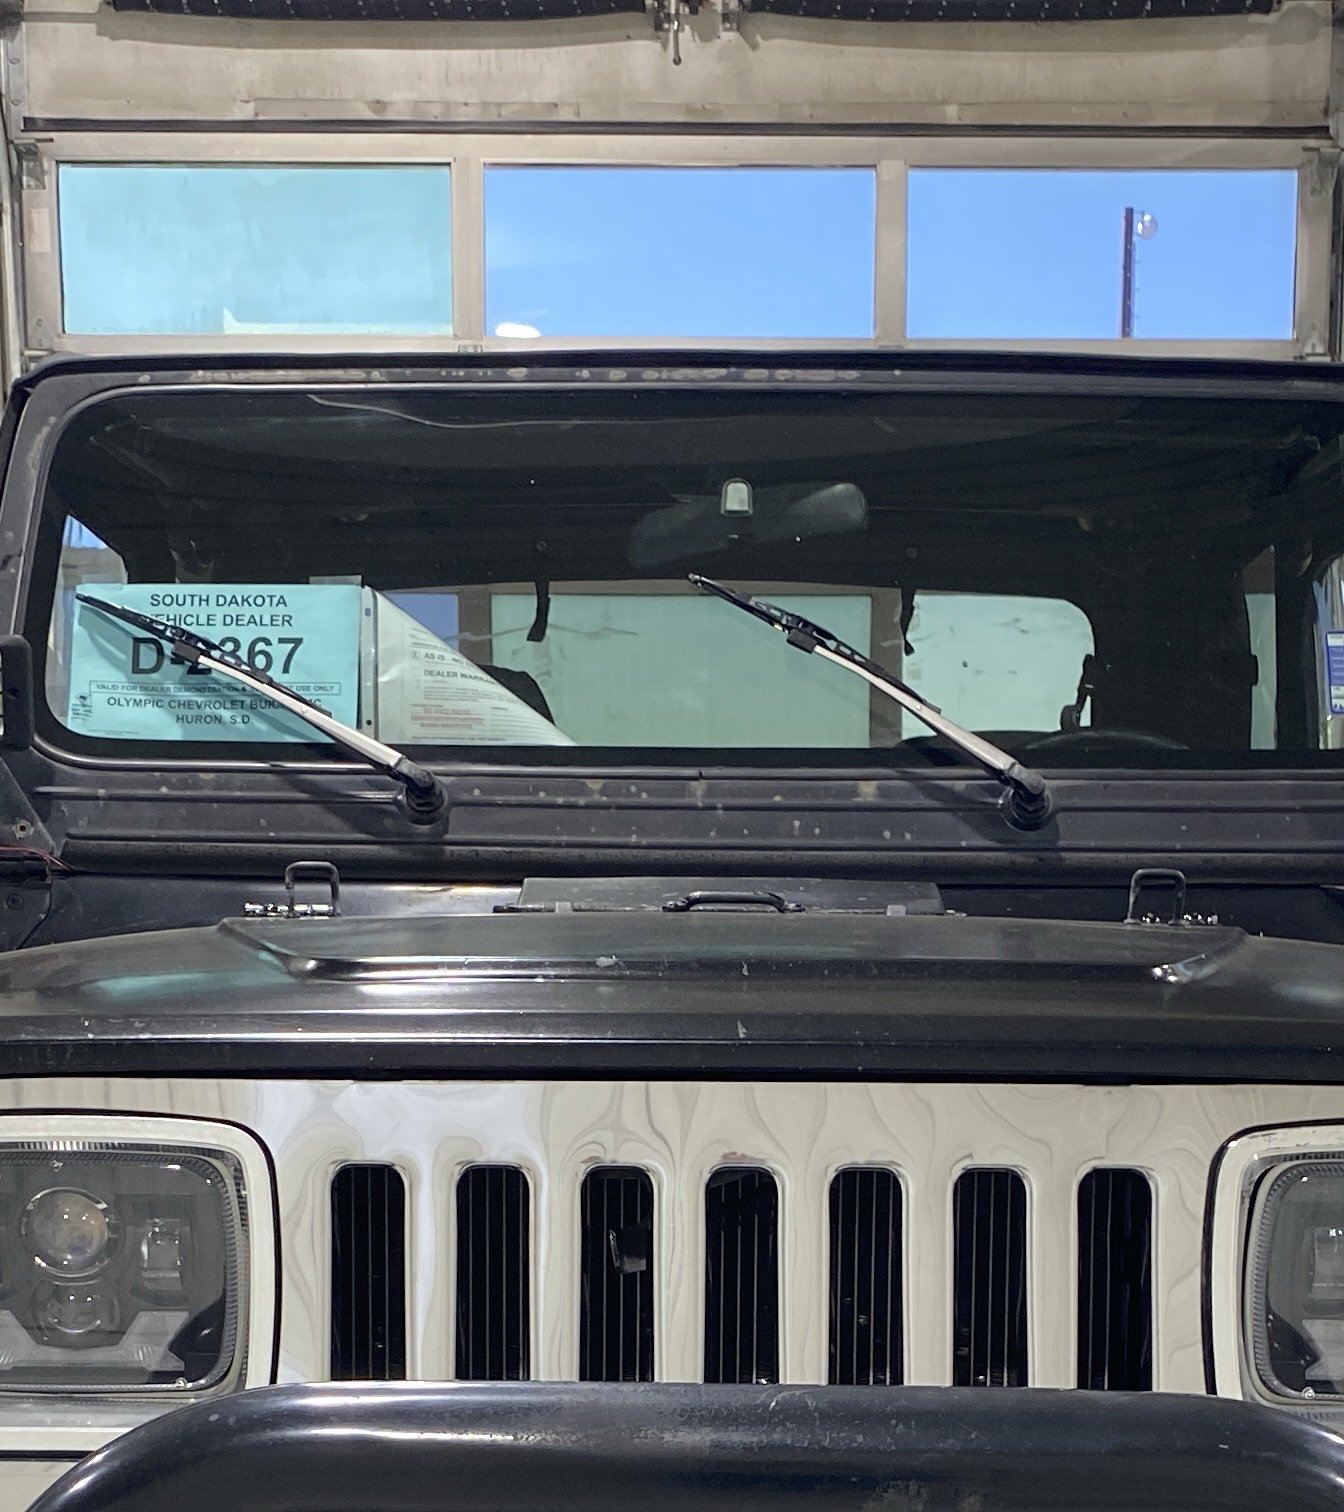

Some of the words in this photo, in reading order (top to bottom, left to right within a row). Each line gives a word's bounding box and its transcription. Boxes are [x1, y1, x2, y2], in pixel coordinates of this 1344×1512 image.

[150, 593, 210, 607] SOUTH
[215, 594, 288, 608] DAKOTA
[150, 613, 217, 627] EHICLE
[222, 613, 293, 628] DEALER
[424, 669, 458, 678] DEALER
[460, 672, 496, 685] WARRA
[96, 683, 120, 692] VALID
[121, 684, 139, 692] FOR
[107, 696, 164, 710] OLYMPIC
[168, 698, 245, 711] CHEVROLET
